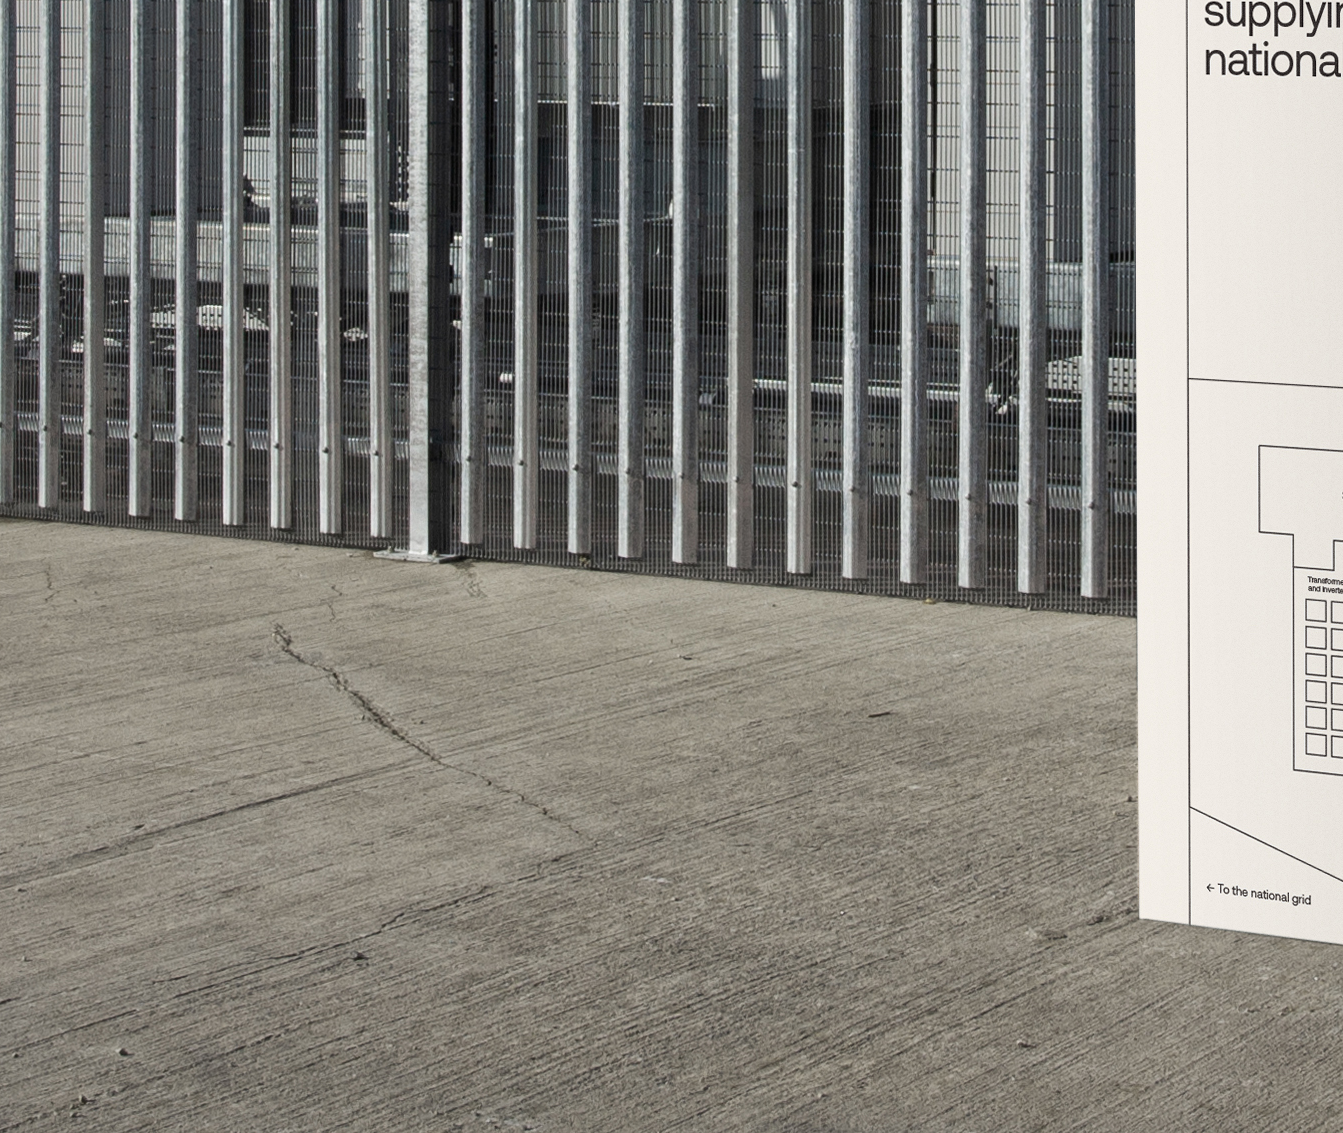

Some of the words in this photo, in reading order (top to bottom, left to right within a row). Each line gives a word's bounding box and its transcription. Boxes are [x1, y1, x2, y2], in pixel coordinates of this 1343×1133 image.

[1217, 883, 1230, 895] To
[1232, 885, 1249, 898] the
[1251, 889, 1290, 903] national
[1292, 894, 1312, 907] grid
